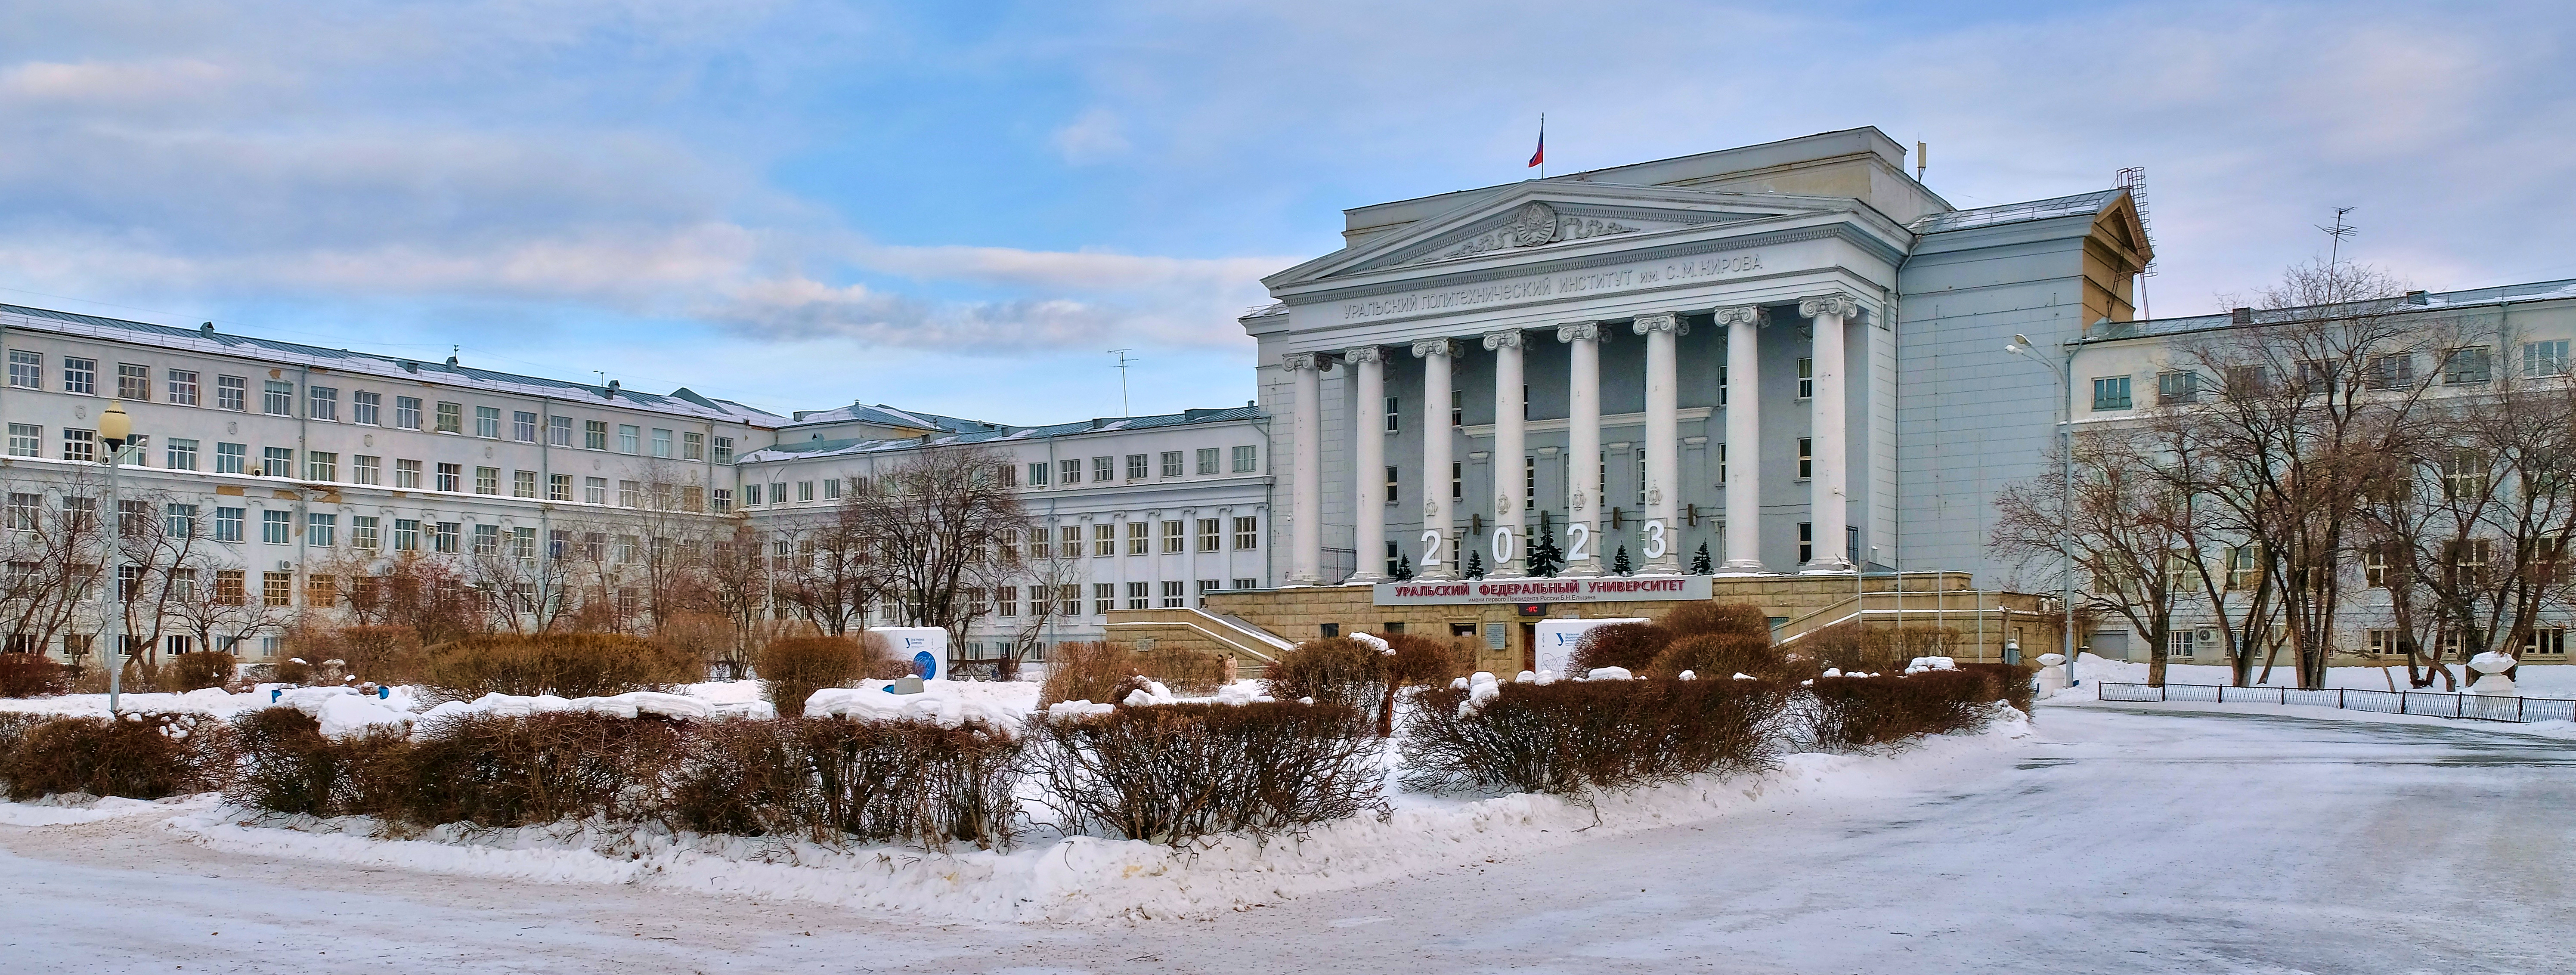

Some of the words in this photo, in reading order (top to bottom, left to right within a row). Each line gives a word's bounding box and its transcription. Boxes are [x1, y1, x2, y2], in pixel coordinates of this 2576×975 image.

[1344, 294, 1417, 319] УРАЛЬСКИЙ
[1559, 269, 1632, 293] ИНСТИТУТ
[1395, 582, 1470, 597] УРАЛЬСКИЙ
[1478, 579, 1579, 597] ФЕДЕРАЛЬНЫЙ
[1588, 579, 1685, 593] УНИВЕРСИТЕТ
